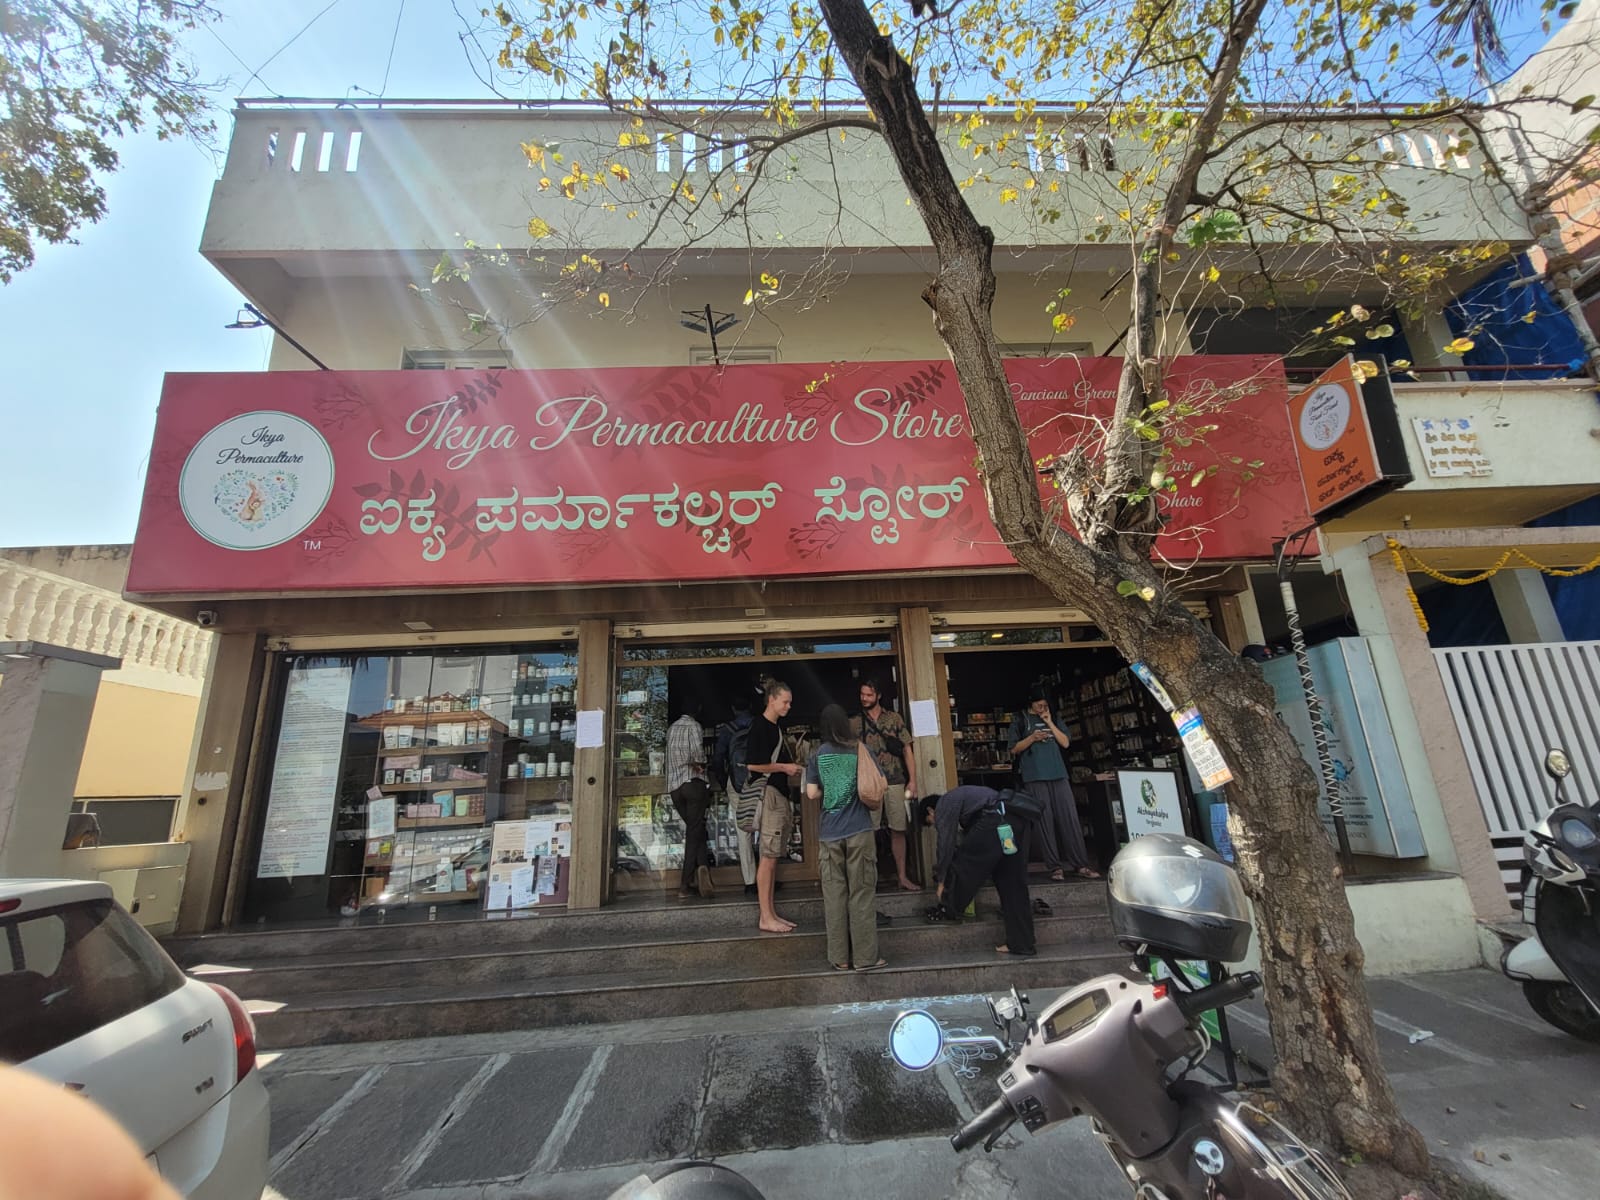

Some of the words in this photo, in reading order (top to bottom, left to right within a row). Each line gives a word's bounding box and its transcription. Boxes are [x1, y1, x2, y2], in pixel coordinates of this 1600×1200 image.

[240, 426, 285, 447] Ikya
[367, 395, 519, 469] Ikya
[529, 394, 819, 451] Permaculture
[830, 388, 965, 446] Store
[216, 448, 304, 465] Permaculture
[359, 488, 447, 562] ಐಕ್ಯ
[476, 482, 783, 554] ಪರ್ಮಾಕಲ್ಚರ್
[814, 475, 970, 545] ಸ್ಟೋರ್
[303, 540, 322, 551] TM
